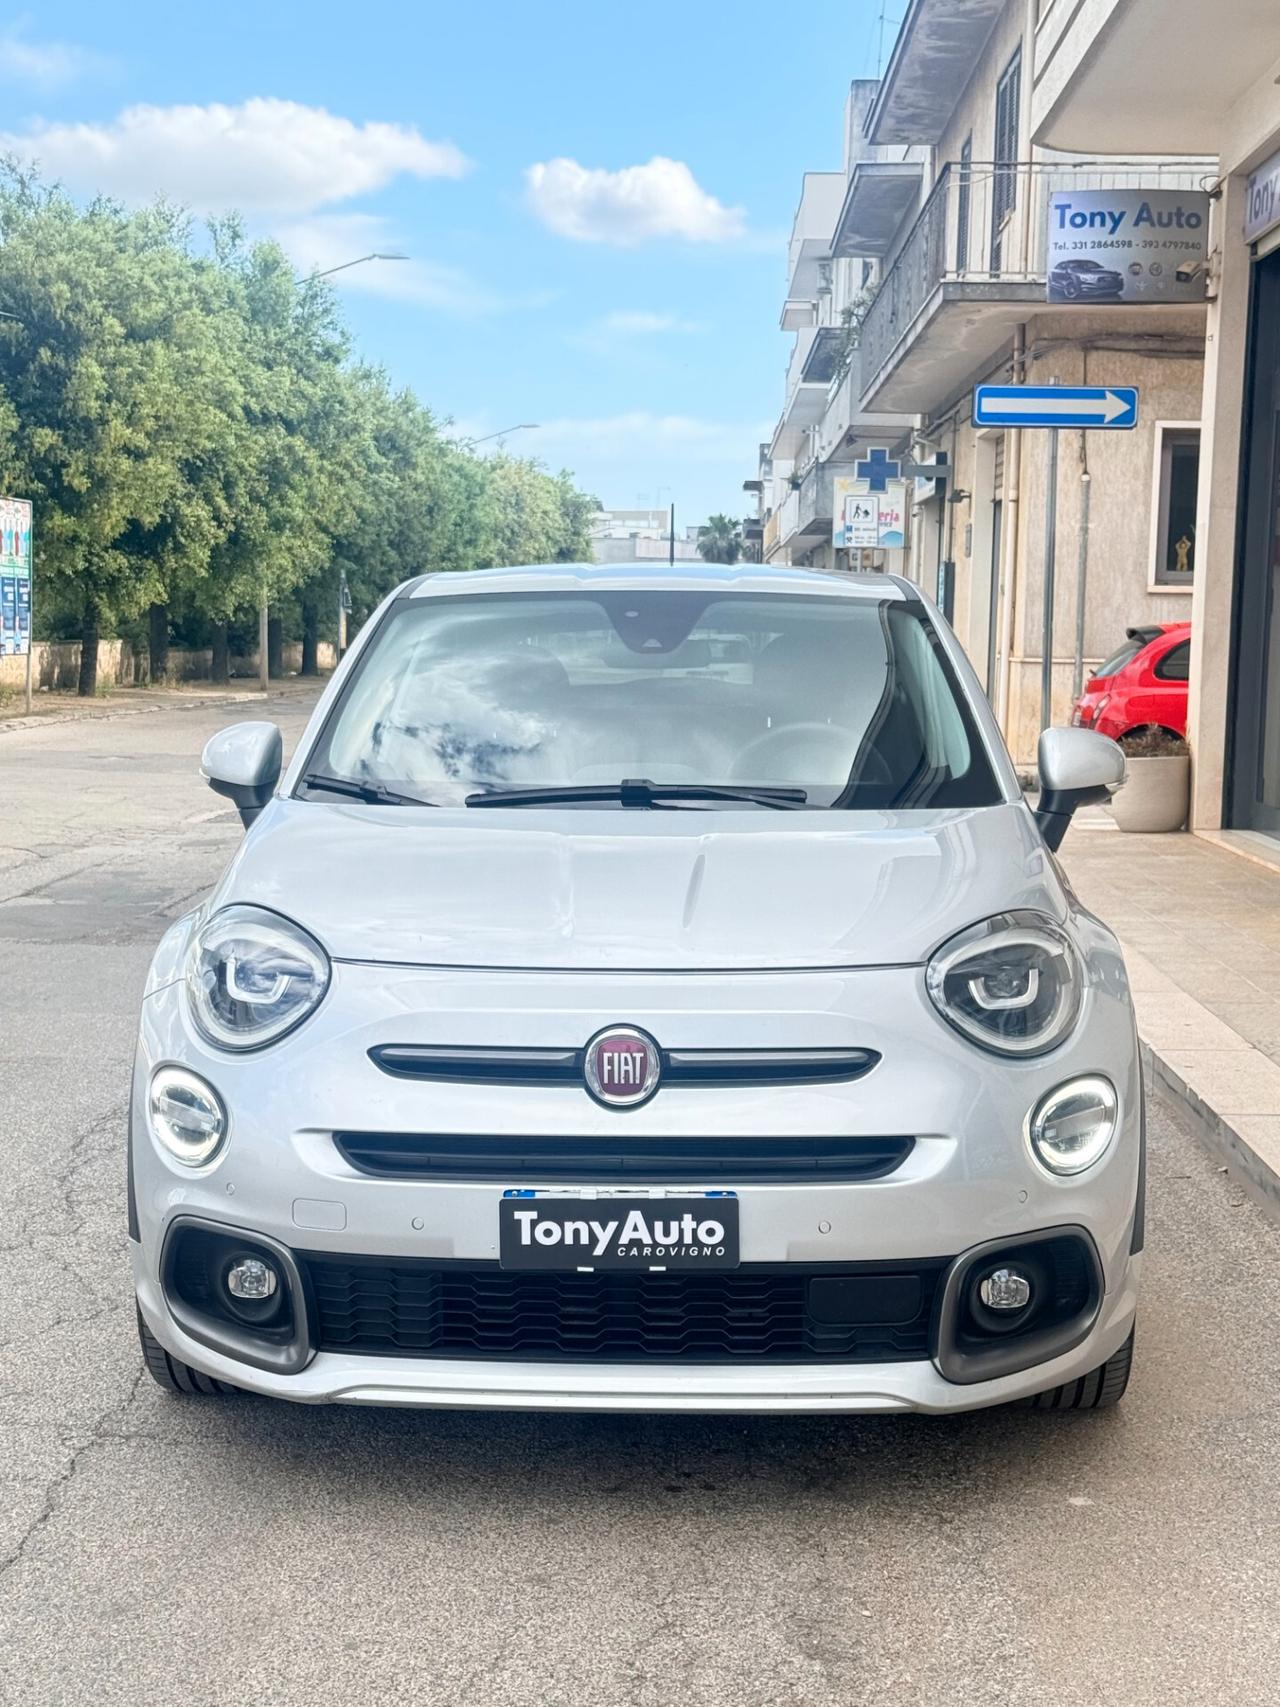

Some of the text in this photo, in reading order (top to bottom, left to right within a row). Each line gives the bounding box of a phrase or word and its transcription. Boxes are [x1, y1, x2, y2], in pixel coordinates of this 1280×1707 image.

[1248, 175, 1278, 224] Tony
[1054, 202, 1202, 235] Tony Auto
[1053, 242, 1069, 250] Tel.
[1072, 241, 1087, 250] 331
[1090, 240, 1133, 249] 2864598
[1141, 240, 1160, 249] 393
[1161, 240, 1201, 250] 4797840
[603, 1052, 644, 1084] FIAT
[513, 1210, 725, 1256] TonyAuto
[617, 1246, 725, 1257] CAROVIGNO
